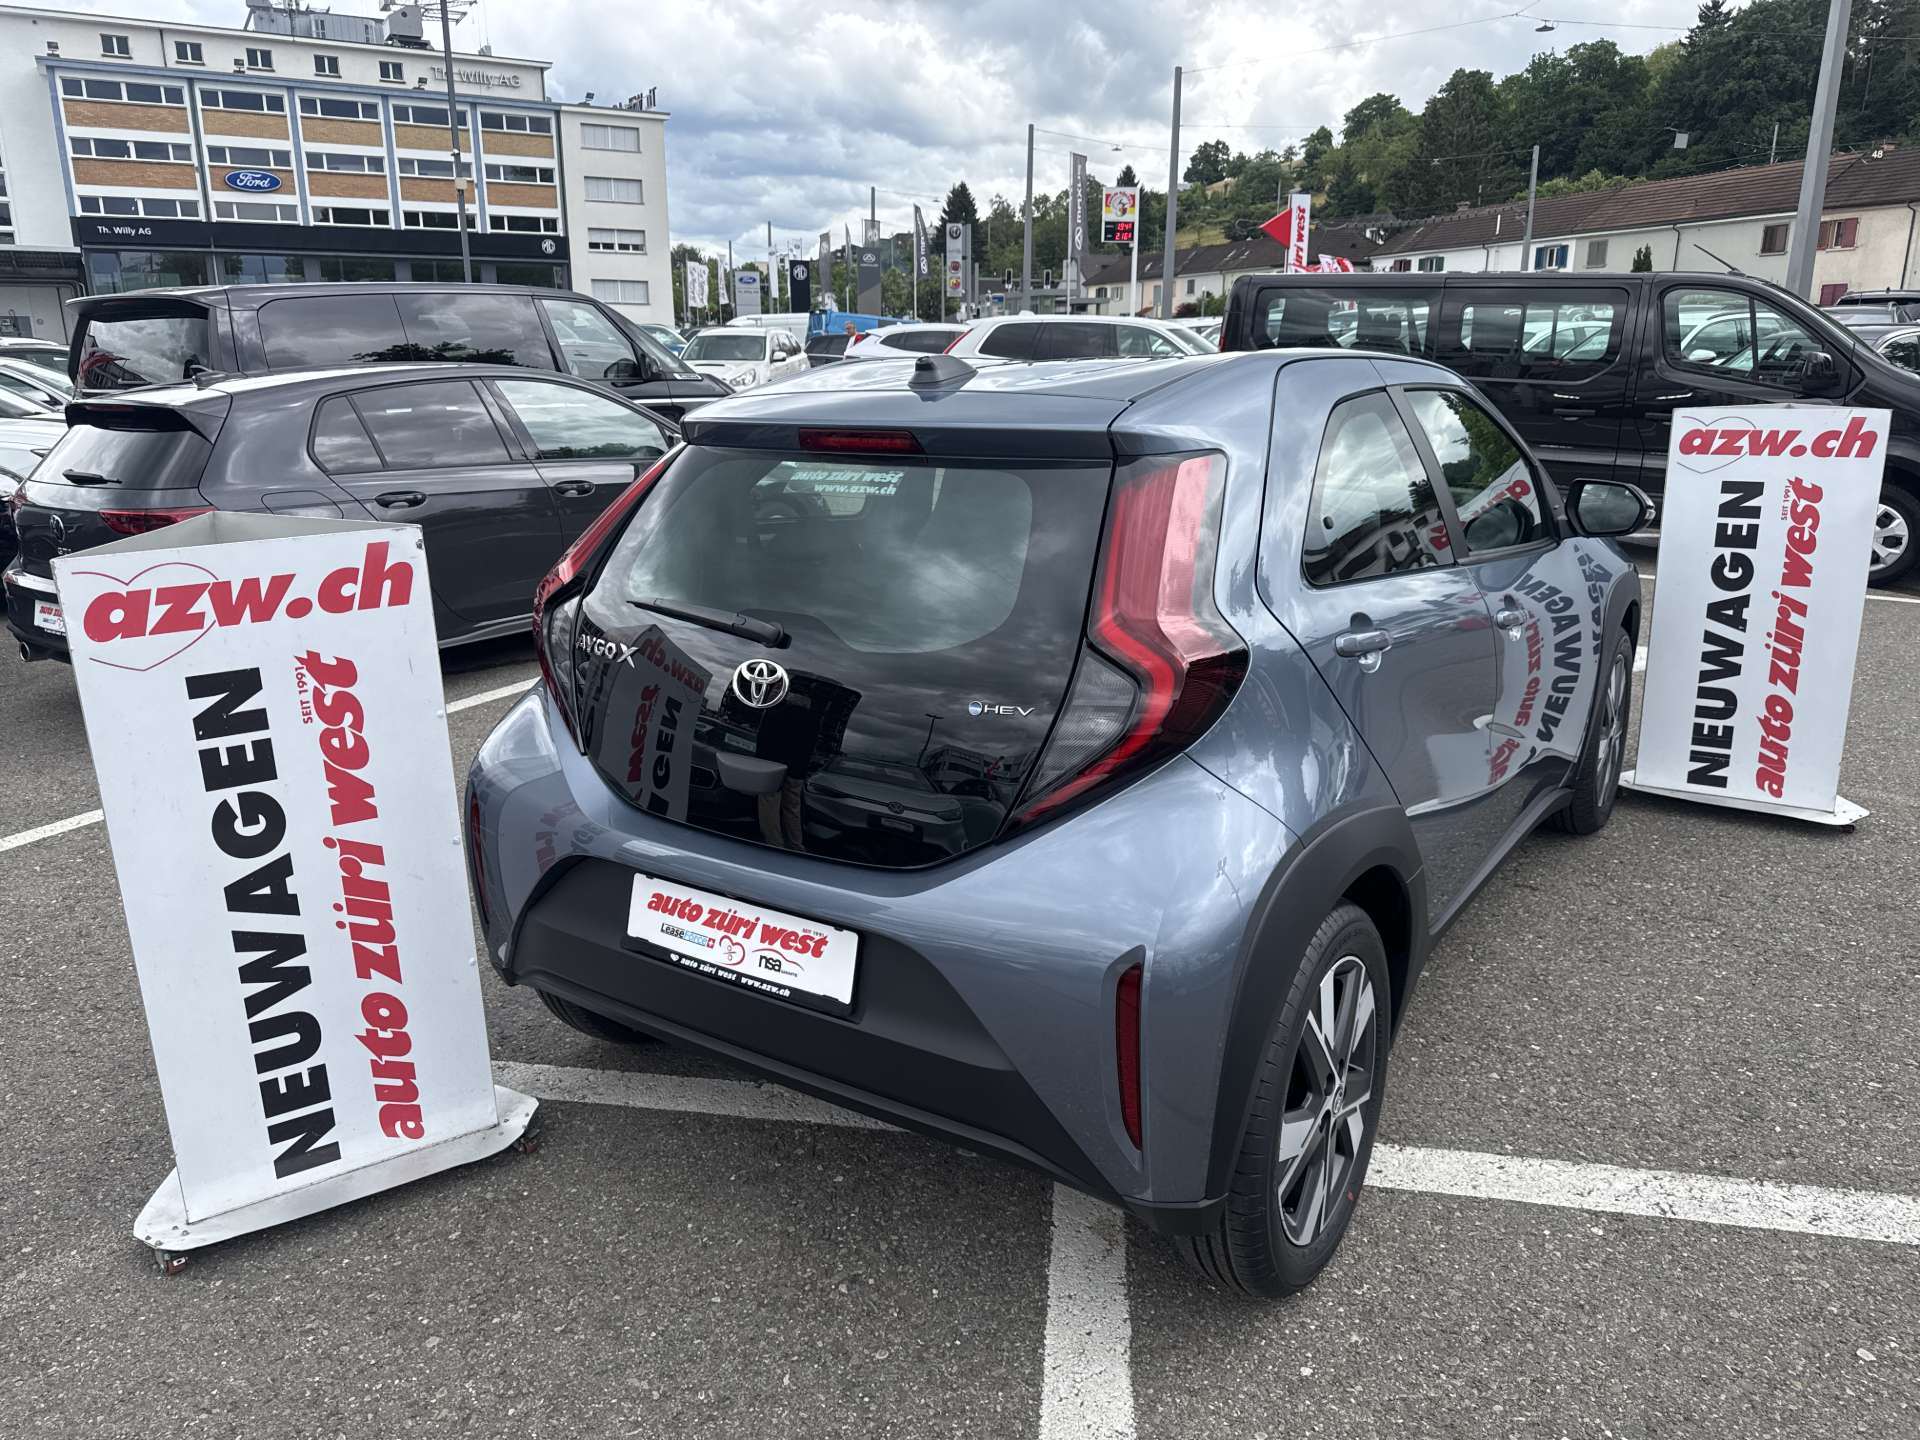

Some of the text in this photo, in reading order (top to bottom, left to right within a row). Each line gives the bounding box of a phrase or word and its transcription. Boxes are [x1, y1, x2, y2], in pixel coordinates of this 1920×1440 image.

[459, 69, 496, 88] Willy
[499, 74, 521, 88] AG
[1871, 150, 1884, 159] 48
[236, 173, 271, 189] Ford
[97, 226, 152, 237] Th. Willy AG
[1297, 205, 1306, 242] west
[793, 264, 808, 281] MG
[1679, 417, 1878, 459] azw.ch
[791, 469, 904, 484] auto züri west
[814, 484, 897, 496] www.azw.ch
[1781, 485, 1791, 521] SEIT 1991
[83, 541, 414, 643] azw.ch
[575, 634, 640, 669] AYGO X
[1686, 480, 1765, 789] NEUWAGEN
[1755, 476, 1824, 799] auto züri west
[295, 666, 313, 724] SEIT 1991
[984, 705, 1035, 717] HEV
[294, 650, 425, 1140] auto züri west
[184, 667, 342, 1180] NEUWAGEN
[647, 892, 830, 959] auto züri west
[660, 922, 708, 947] LeaseForce
[680, 957, 792, 998] auto züri west www.azw.ch
[758, 954, 782, 974] nsa
